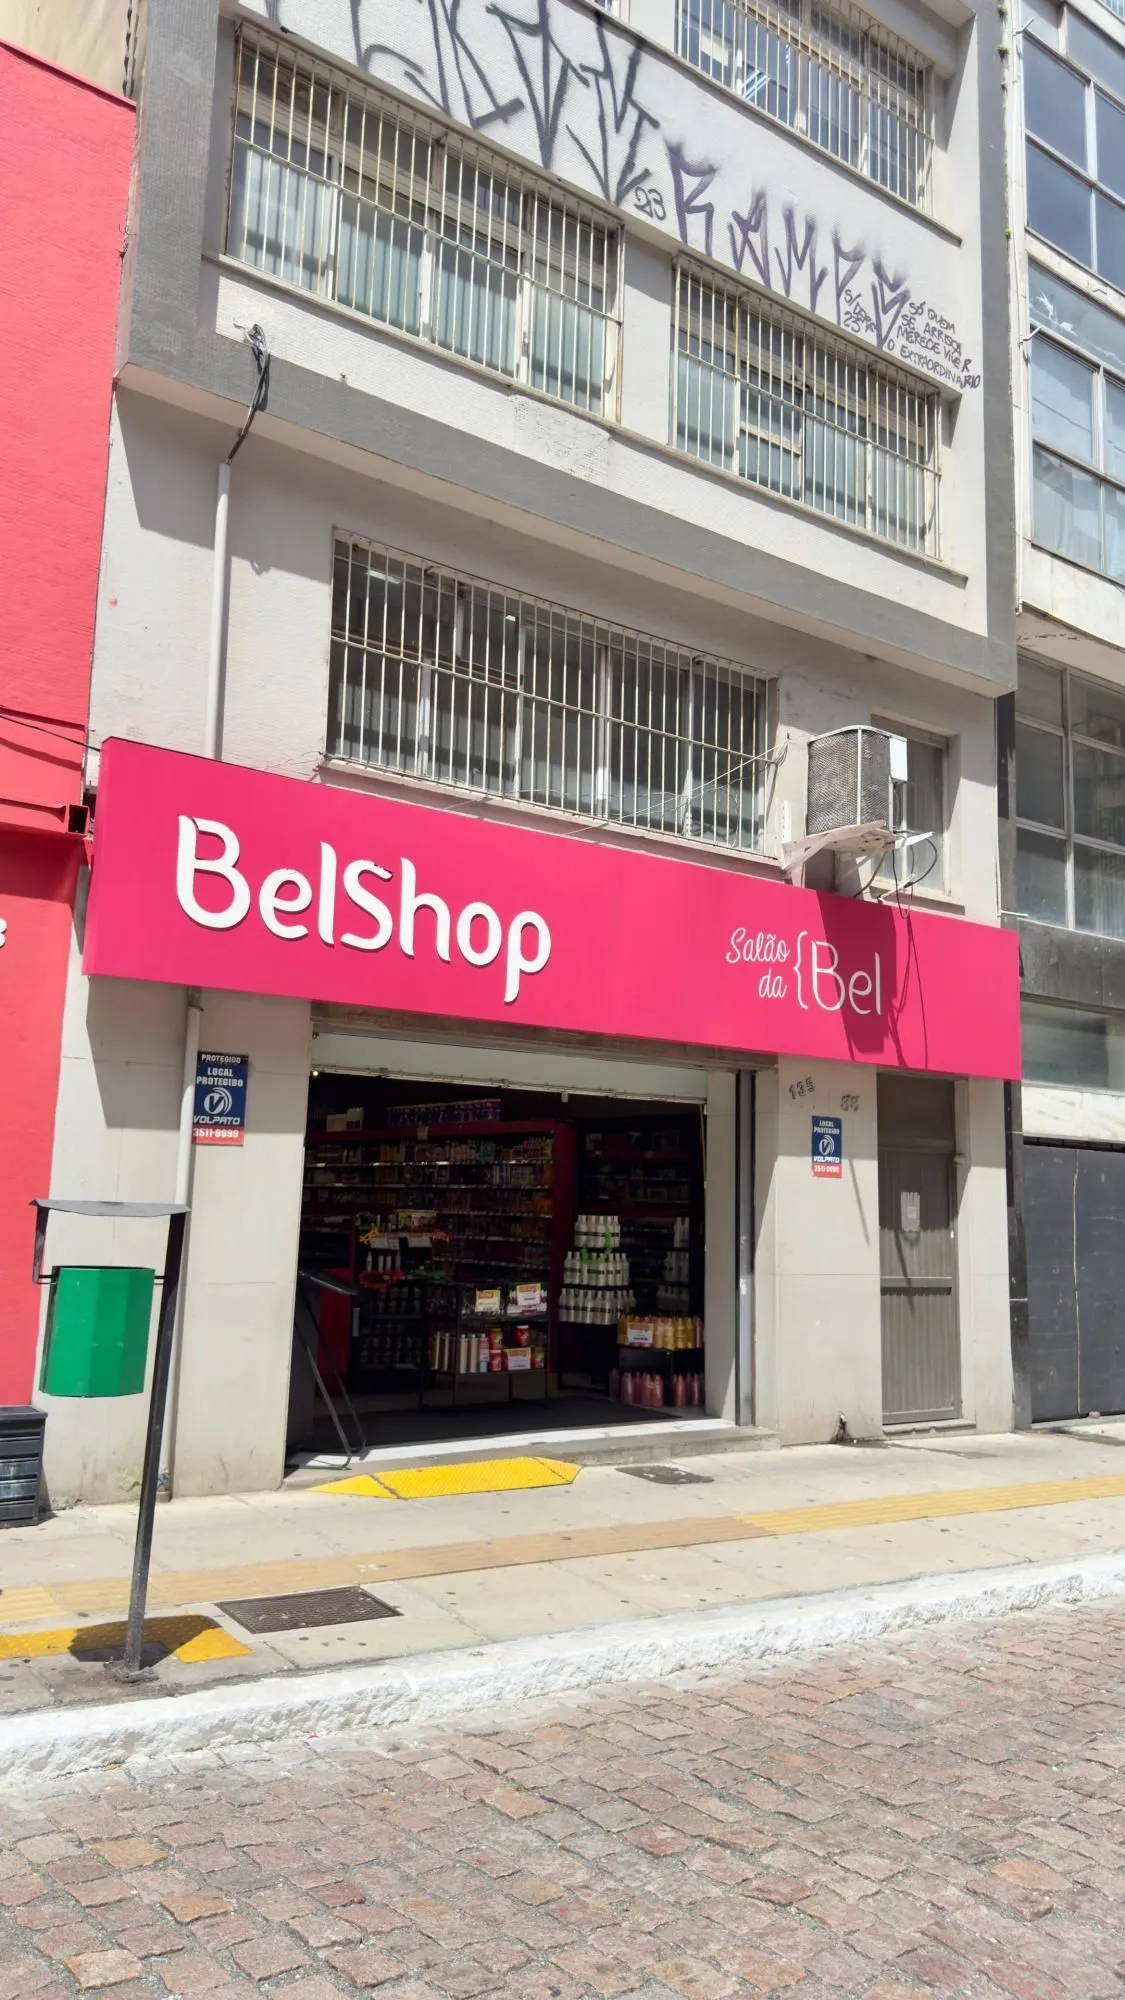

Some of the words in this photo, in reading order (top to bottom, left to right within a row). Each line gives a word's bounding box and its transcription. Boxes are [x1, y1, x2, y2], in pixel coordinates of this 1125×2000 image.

[901, 314, 917, 331] SE
[927, 308, 956, 334] QUEM
[896, 324, 941, 355] MERECE
[176, 814, 552, 1005] BelShop
[725, 927, 791, 964] Salão
[758, 967, 788, 999] da
[201, 1053, 242, 1064] PROTEGIDO
[196, 1075, 244, 1087] PROTEGIDO
[207, 1067, 234, 1077] LOCAL
[788, 1077, 815, 1100] 135
[193, 1115, 241, 1126] VOLPATO
